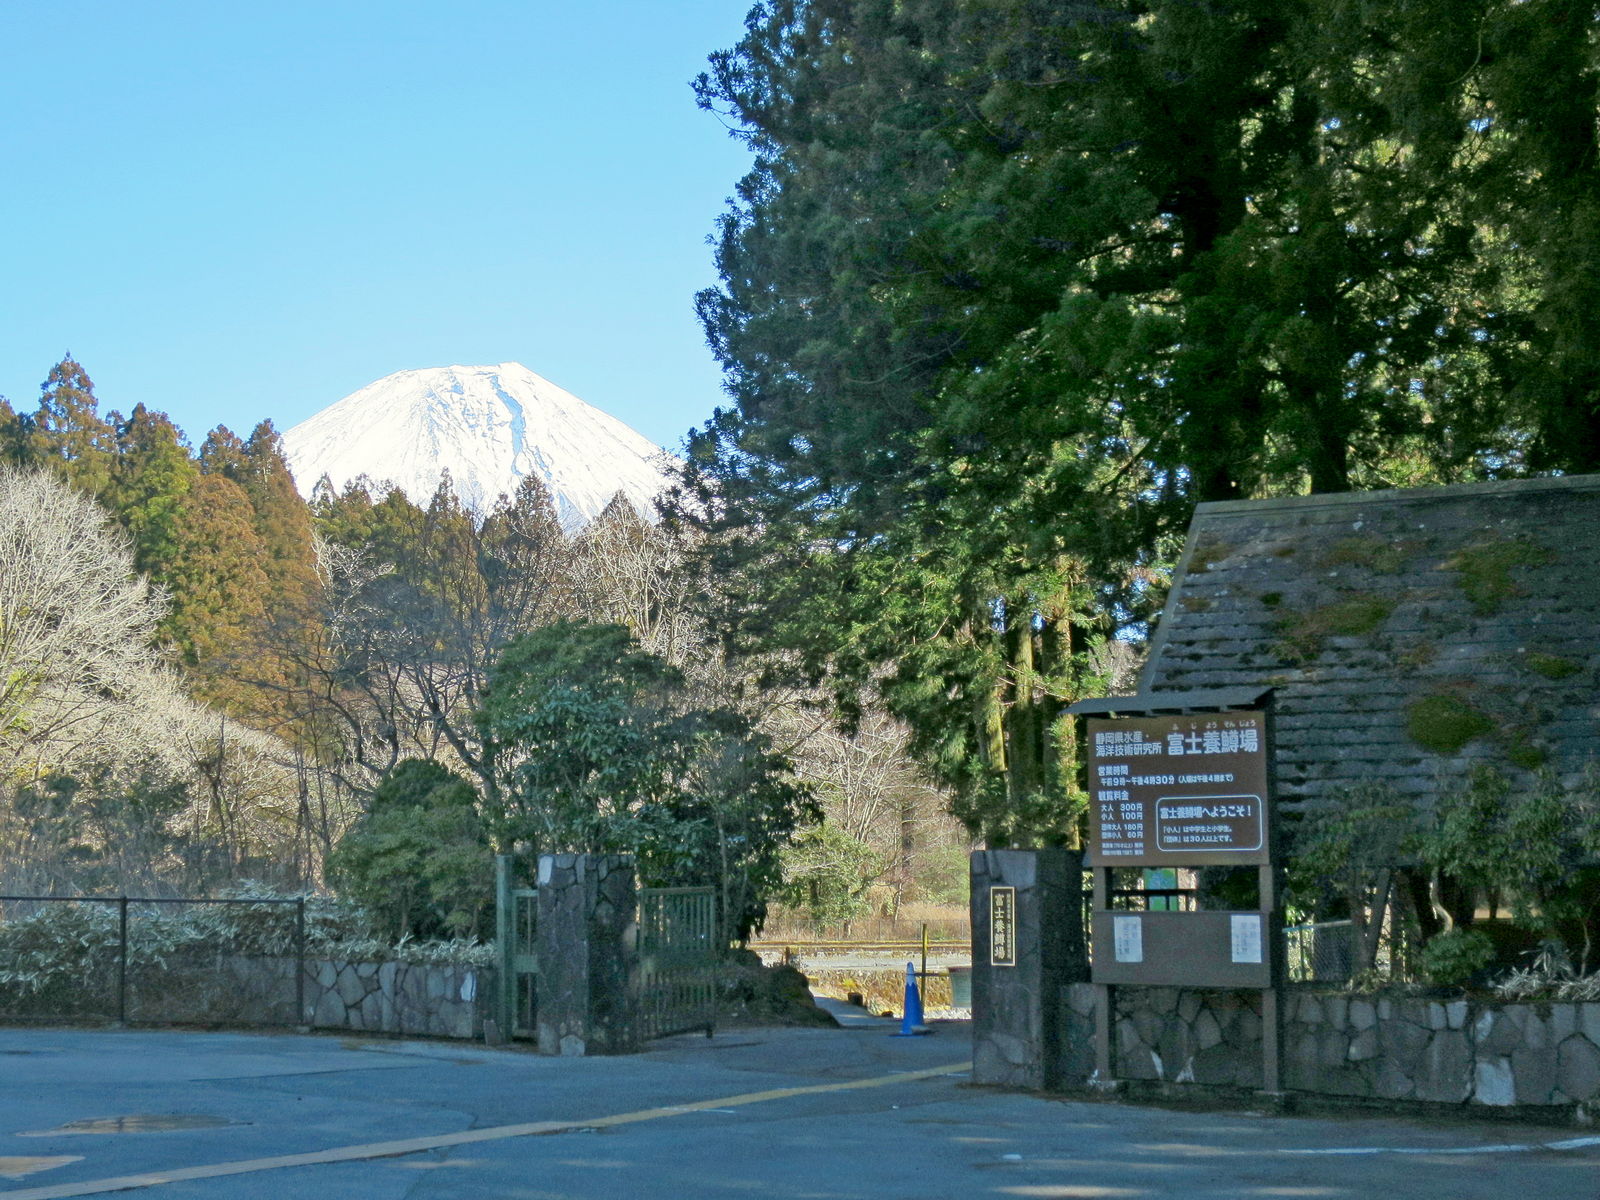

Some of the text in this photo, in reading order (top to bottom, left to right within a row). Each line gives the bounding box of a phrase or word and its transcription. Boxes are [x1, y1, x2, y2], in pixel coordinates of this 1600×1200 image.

[1167, 729, 1258, 755] 富士養鱒場
[1096, 742, 1162, 757] 海洋技術研究所
[1098, 765, 1129, 776] 営業時間
[1098, 790, 1129, 801] 観覧料金
[1101, 803, 1142, 812] 大人 300円
[1121, 812, 1143, 820] 100円
[994, 893, 1005, 959] 富士養鱒場
